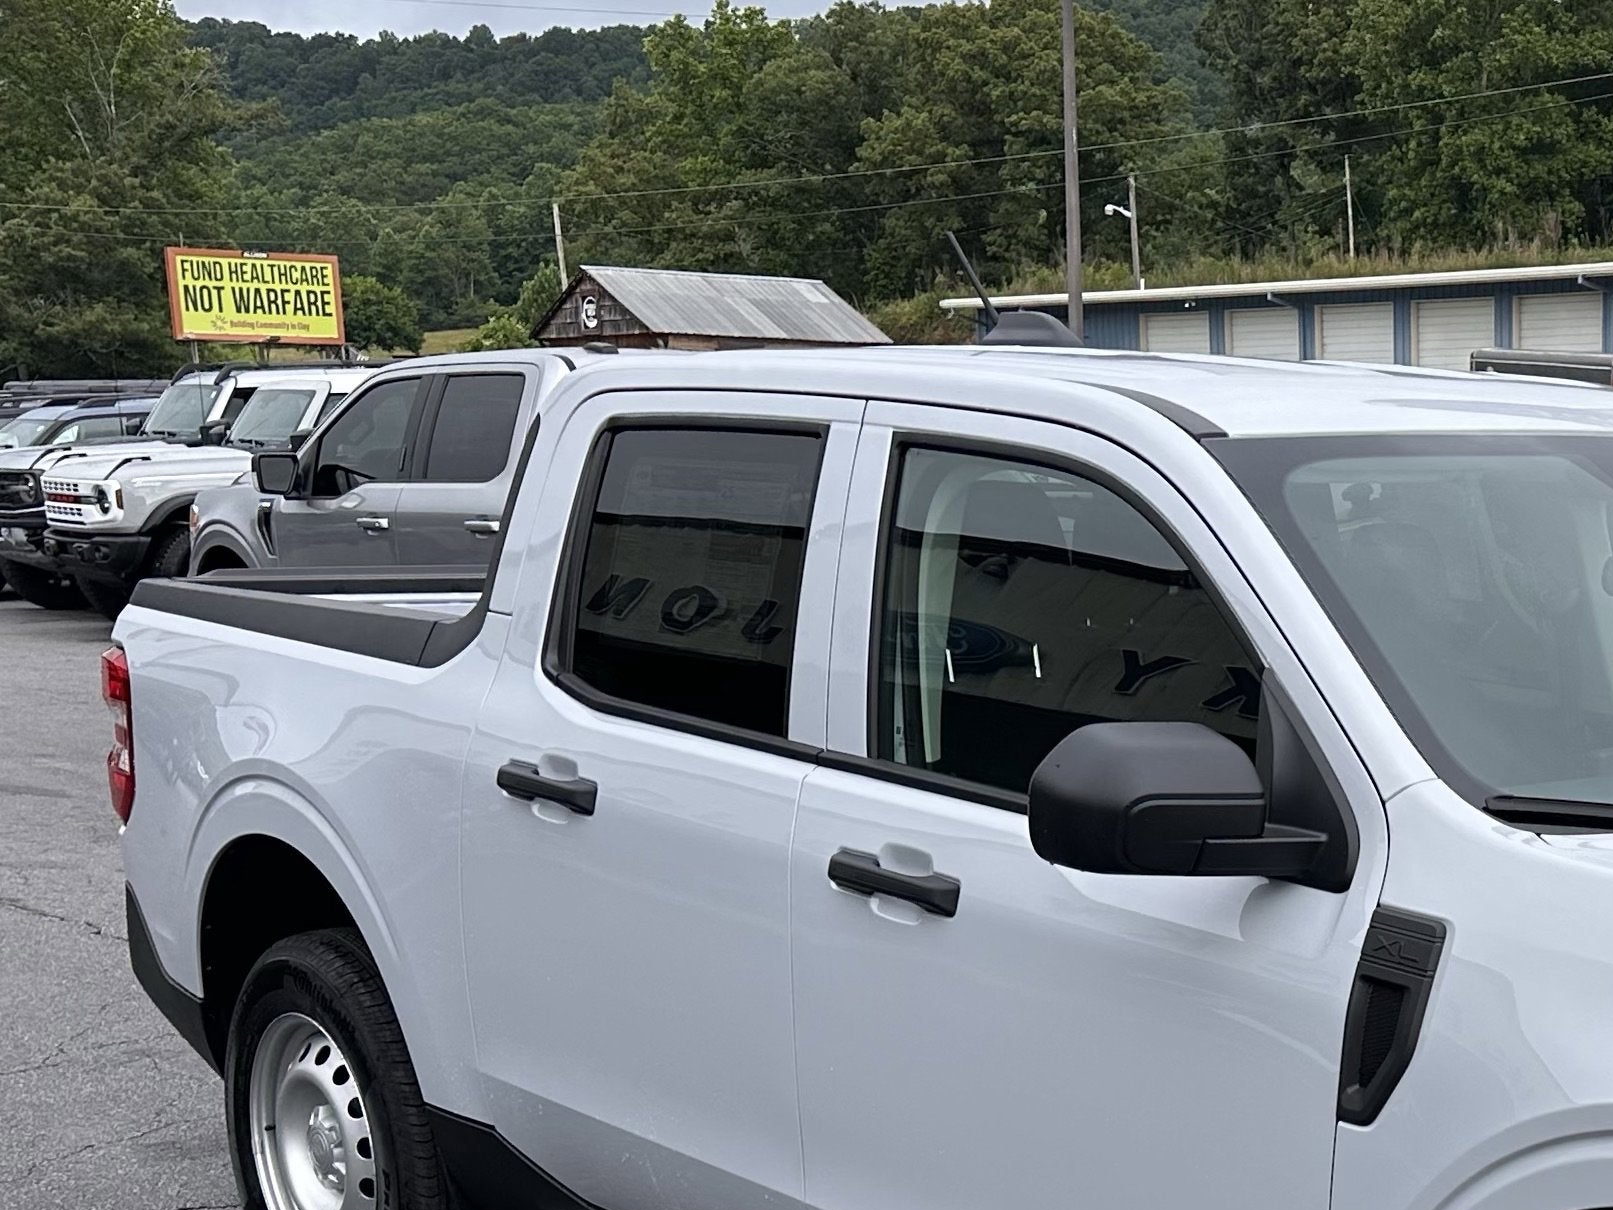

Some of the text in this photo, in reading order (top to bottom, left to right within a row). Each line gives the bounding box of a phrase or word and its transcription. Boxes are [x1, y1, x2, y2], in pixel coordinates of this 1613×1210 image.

[180, 258, 330, 287] FUND HEALTHCARE
[183, 284, 333, 317] NOT WARFARE
[1373, 934, 1420, 963] XL
